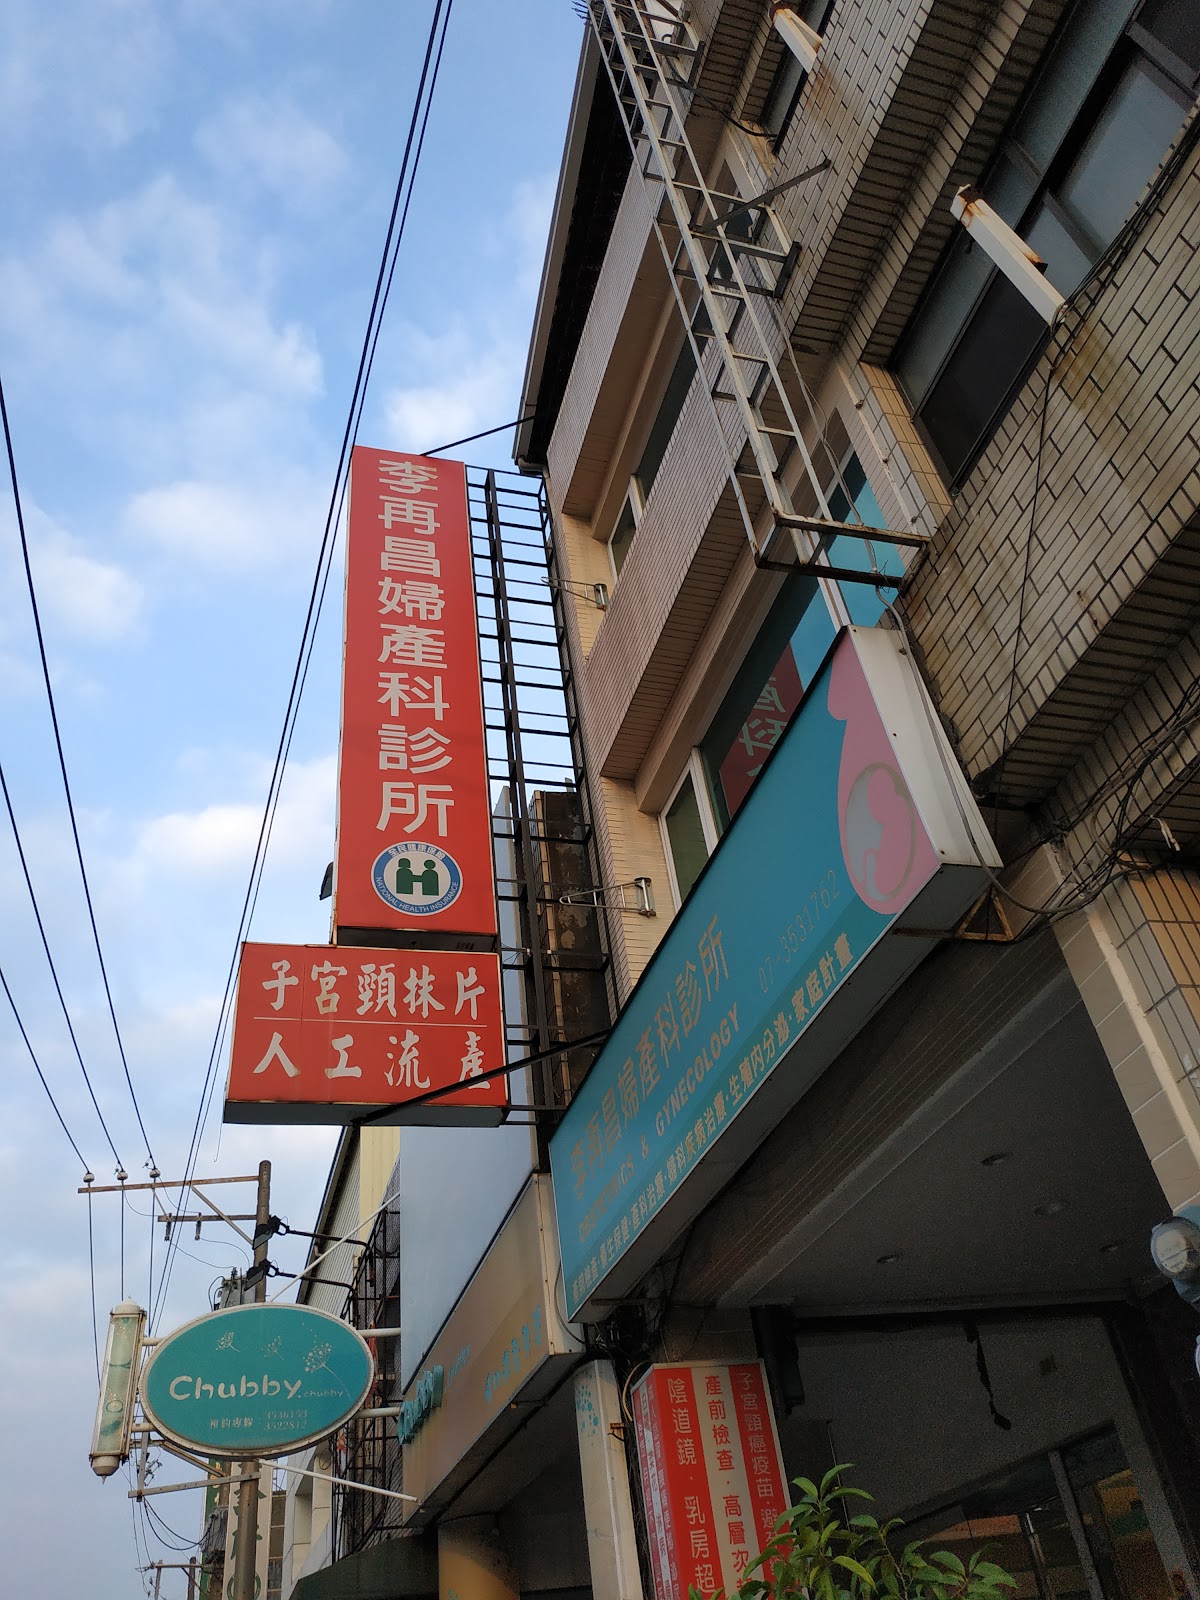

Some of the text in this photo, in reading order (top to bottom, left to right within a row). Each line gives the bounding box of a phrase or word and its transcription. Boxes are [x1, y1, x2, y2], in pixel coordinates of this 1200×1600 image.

[376, 459, 455, 838] 李再昌婦產科診所
[375, 876, 459, 913] NATIONAL HEALTH INSURANCE
[262, 959, 486, 1021] 子宮頸抹片
[640, 1134, 649, 1160] &
[655, 1002, 740, 1137] GYNECOLOGY
